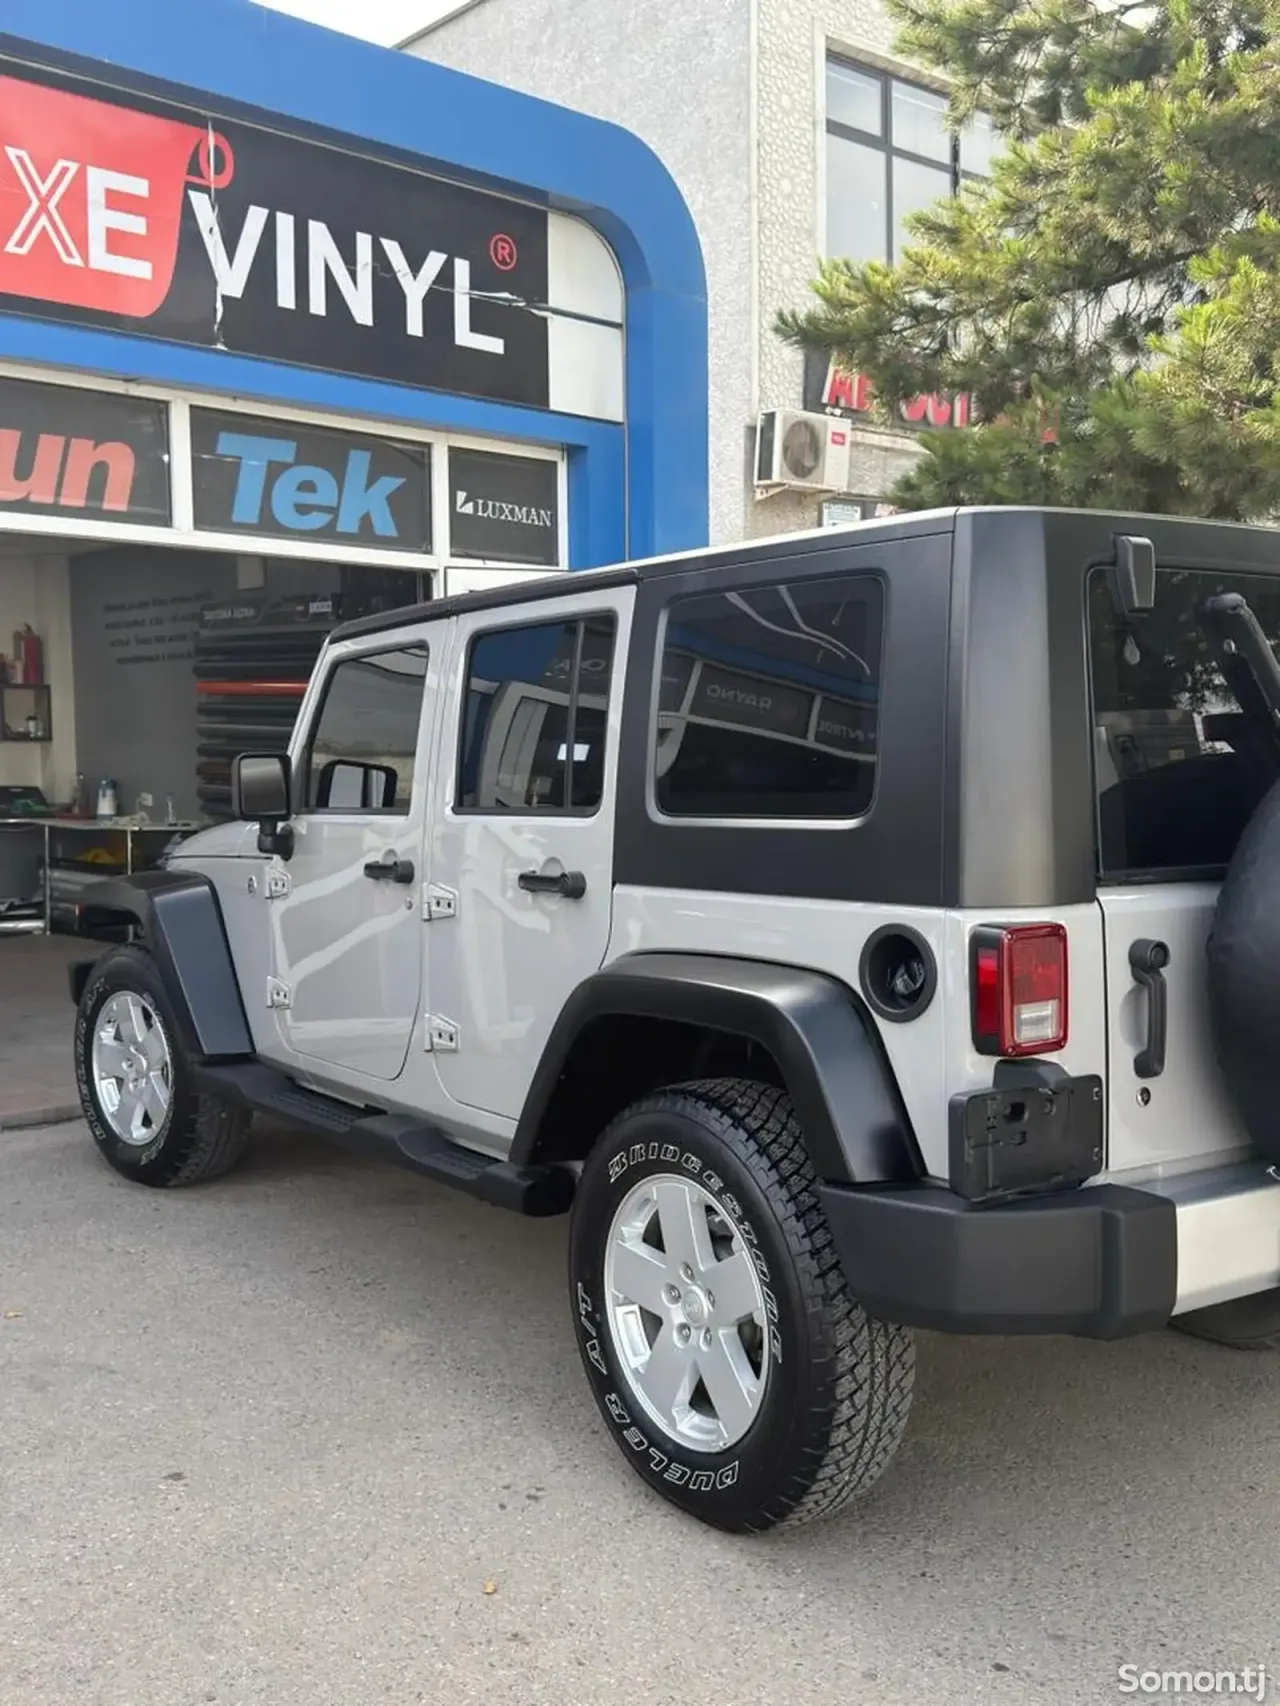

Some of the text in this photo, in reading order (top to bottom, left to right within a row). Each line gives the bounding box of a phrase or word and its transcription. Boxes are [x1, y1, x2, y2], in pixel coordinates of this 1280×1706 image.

[187, 189, 505, 354] VINYL
[215, 431, 407, 538] Tek
[474, 498, 552, 528] LUXMAN
[608, 1142, 782, 1364] BRIDGESTONE
[577, 1282, 739, 1491] DUELER A/T
